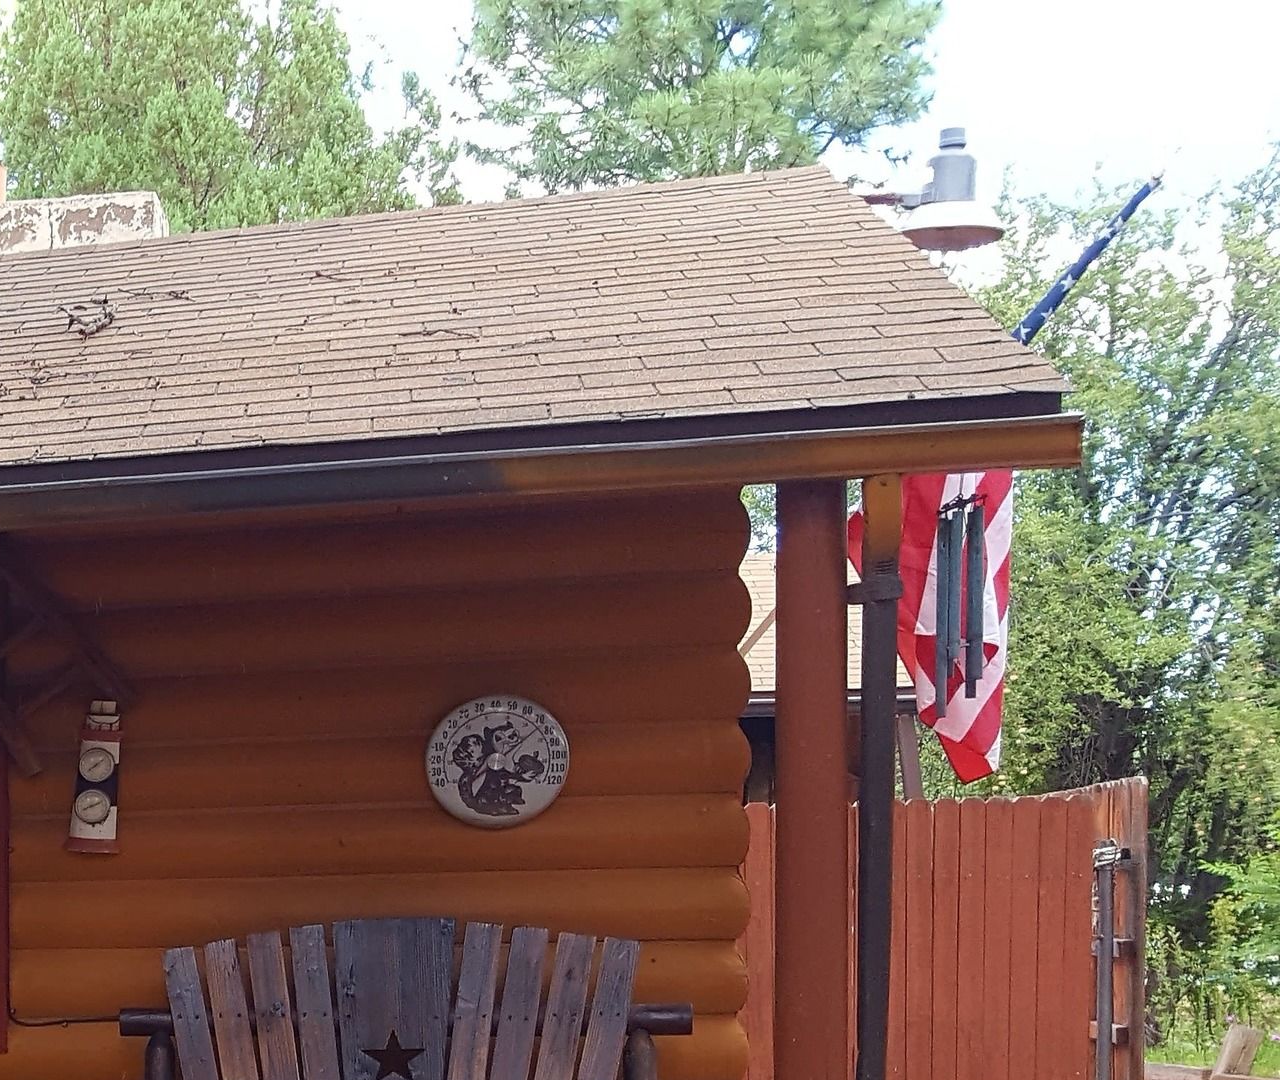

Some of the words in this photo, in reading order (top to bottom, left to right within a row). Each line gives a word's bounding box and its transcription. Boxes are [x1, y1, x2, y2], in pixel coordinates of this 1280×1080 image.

[474, 703, 485, 712] 30
[507, 701, 518, 710] 50
[535, 714, 545, 724] 70
[448, 720, 458, 729] 10
[544, 725, 555, 735] 80
[442, 731, 448, 739] 0
[549, 738, 560, 747] 90
[551, 750, 568, 759] 100
[551, 763, 565, 772] 110
[547, 775, 562, 785] 120
